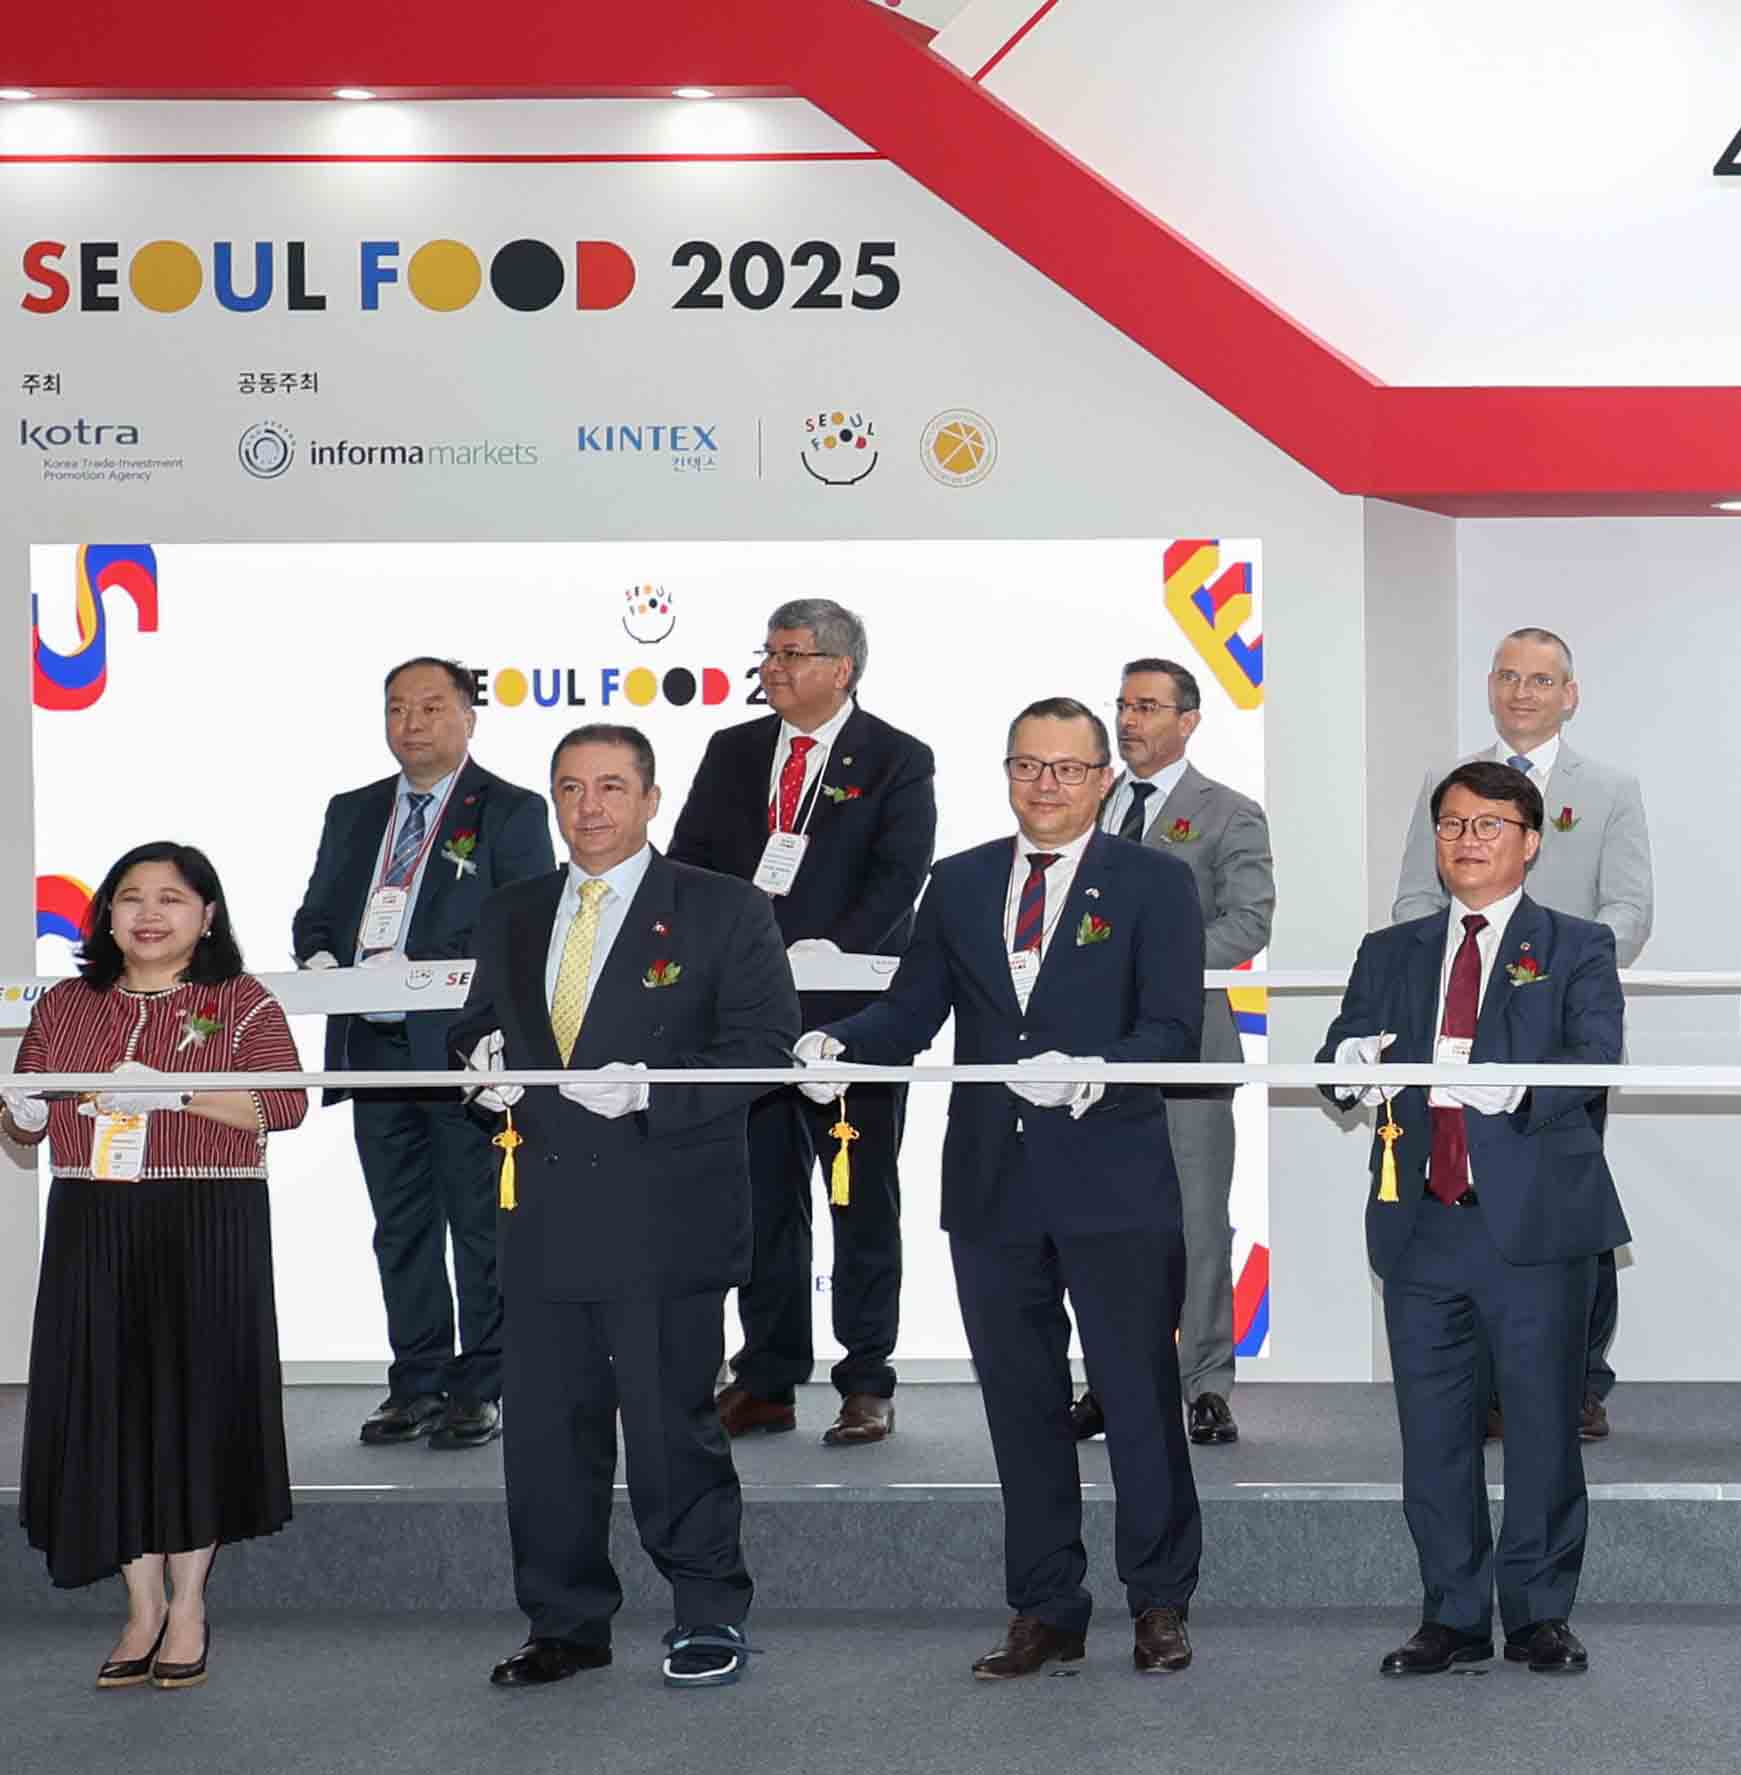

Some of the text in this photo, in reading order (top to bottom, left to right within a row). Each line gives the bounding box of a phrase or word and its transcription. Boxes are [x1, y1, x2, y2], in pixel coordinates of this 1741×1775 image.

[21, 238, 901, 313] SEOUL FOOD 2025
[22, 373, 61, 395] 주최
[238, 372, 319, 394] 공동주최
[577, 426, 717, 451] KINTEX
[310, 441, 538, 465] informa markets
[472, 666, 586, 708] EOUL
[601, 666, 731, 708] FOOD
